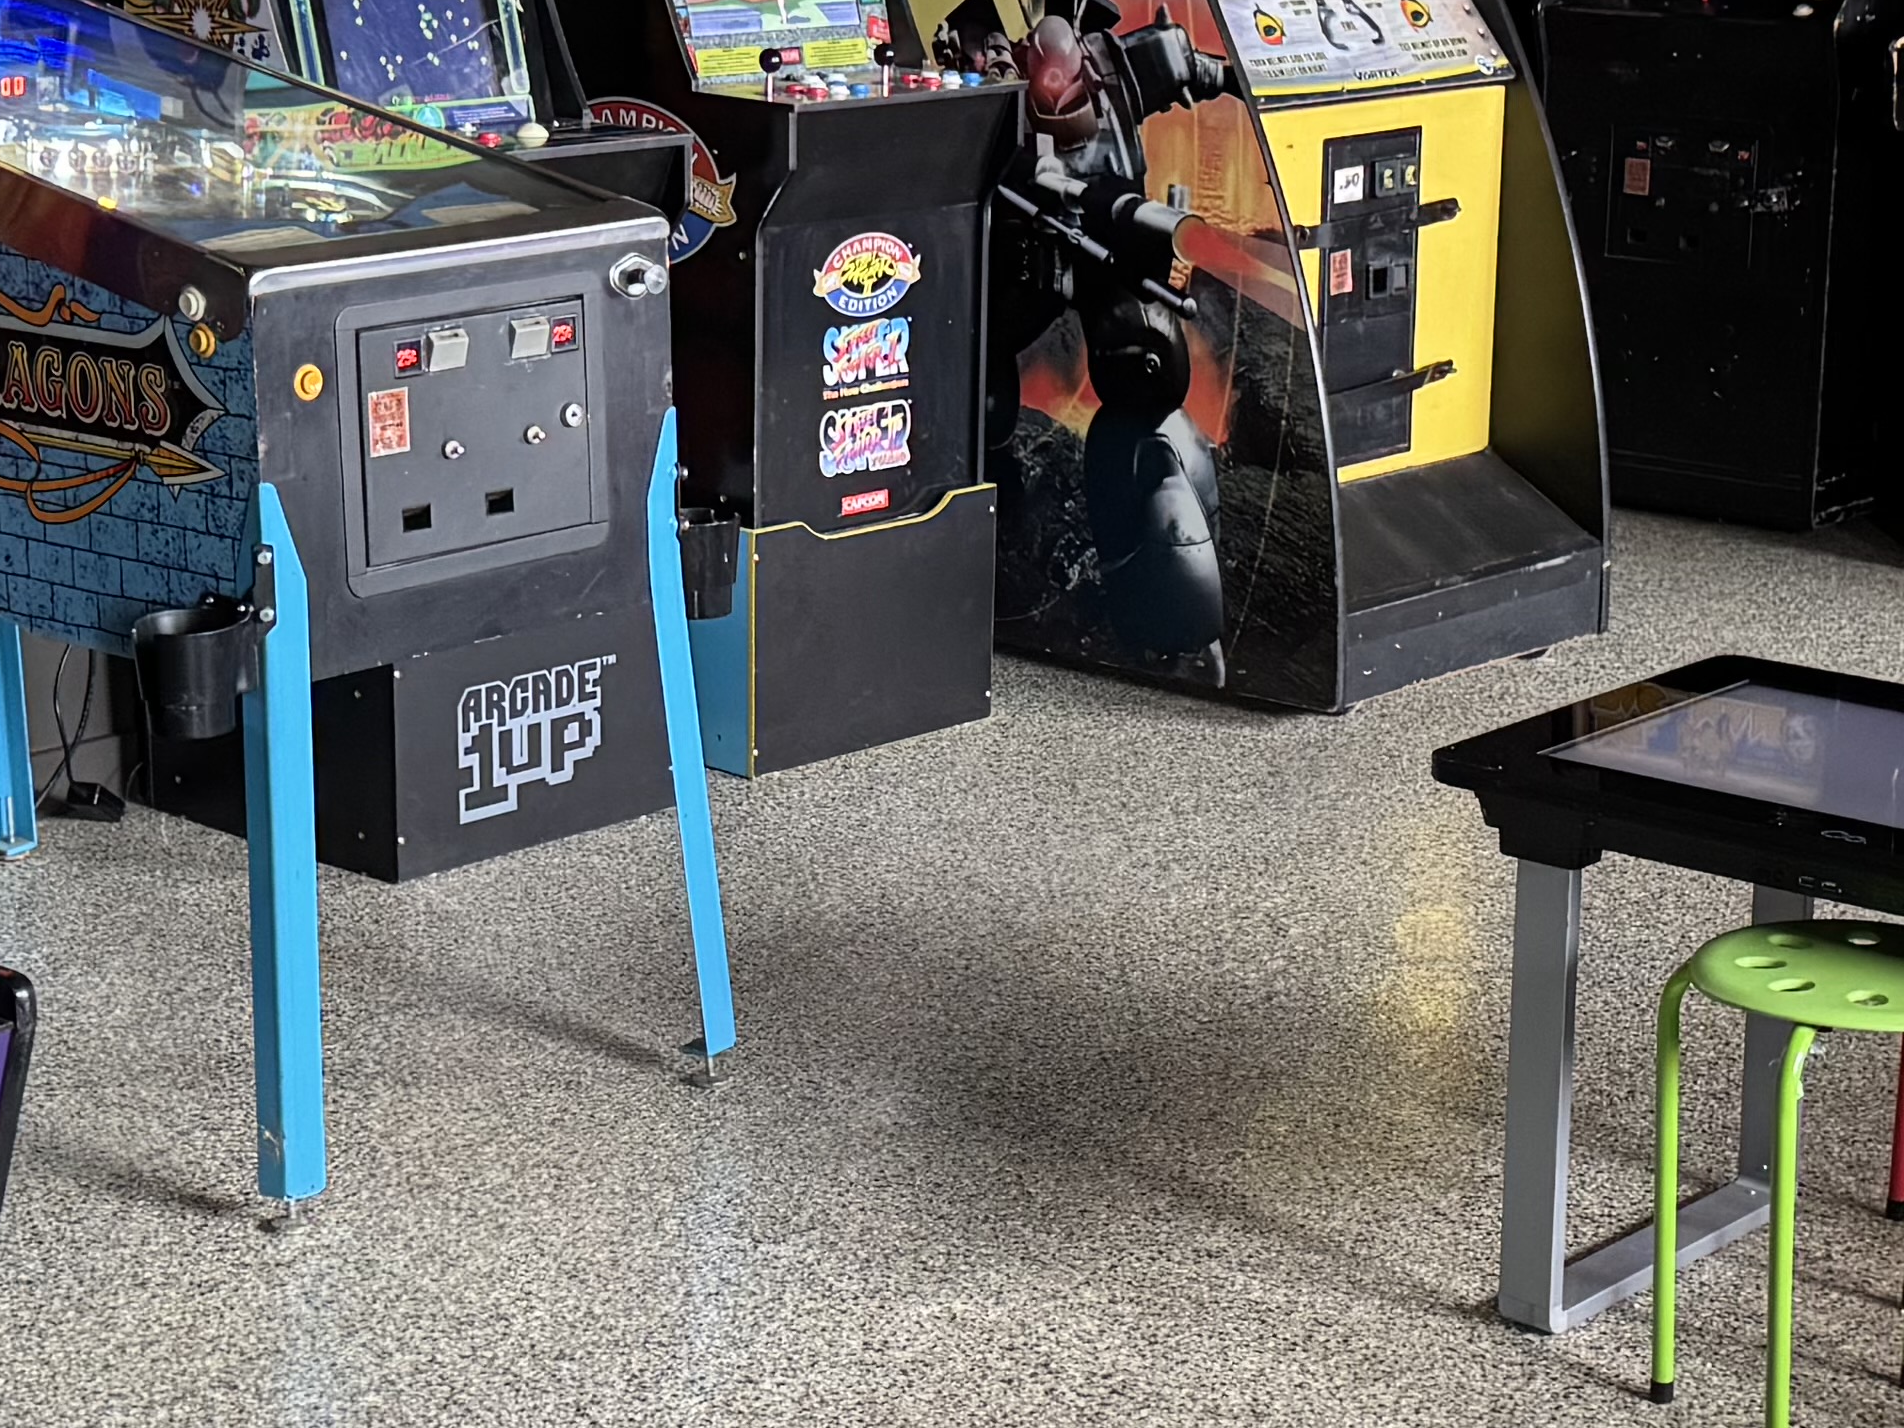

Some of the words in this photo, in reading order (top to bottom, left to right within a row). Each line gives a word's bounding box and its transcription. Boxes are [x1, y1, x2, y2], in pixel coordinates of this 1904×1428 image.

[0, 75, 26, 98] 00
[832, 237, 904, 269] CHAMPION
[838, 285, 899, 312] EDITION
[844, 493, 887, 511] CAPCOM
[457, 657, 602, 734] ARCADE
[458, 706, 602, 825] 1UP
